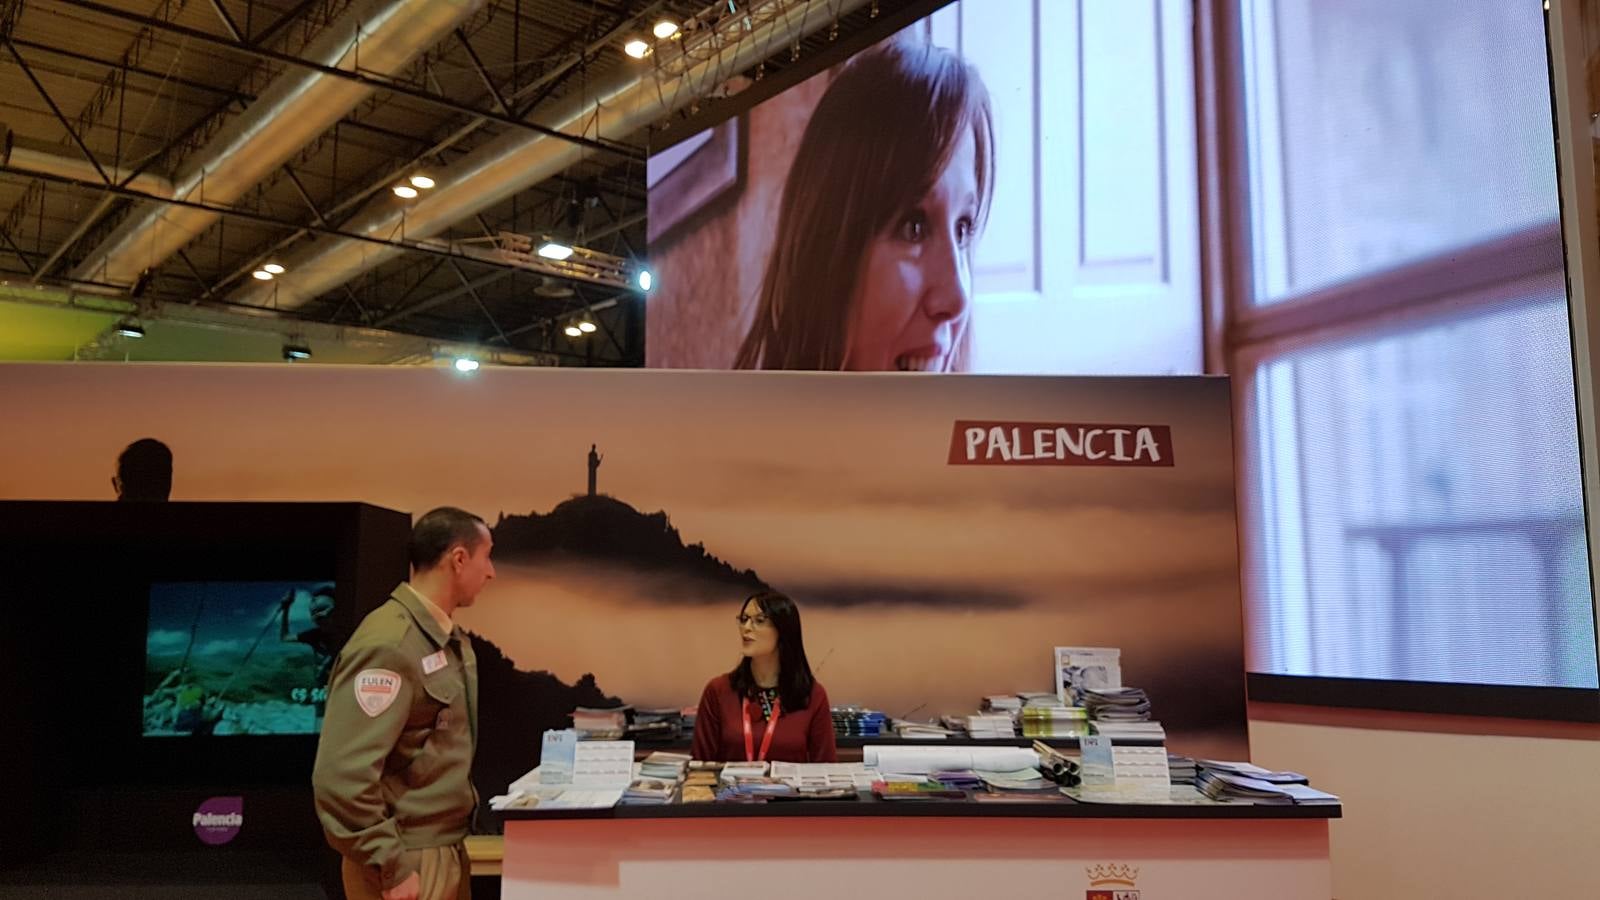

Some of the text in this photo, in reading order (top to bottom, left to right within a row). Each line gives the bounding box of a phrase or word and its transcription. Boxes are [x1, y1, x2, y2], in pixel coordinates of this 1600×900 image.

[964, 426, 1161, 462] PALENCIA
[361, 677, 393, 686] EULEN
[192, 812, 243, 827] Palencia
